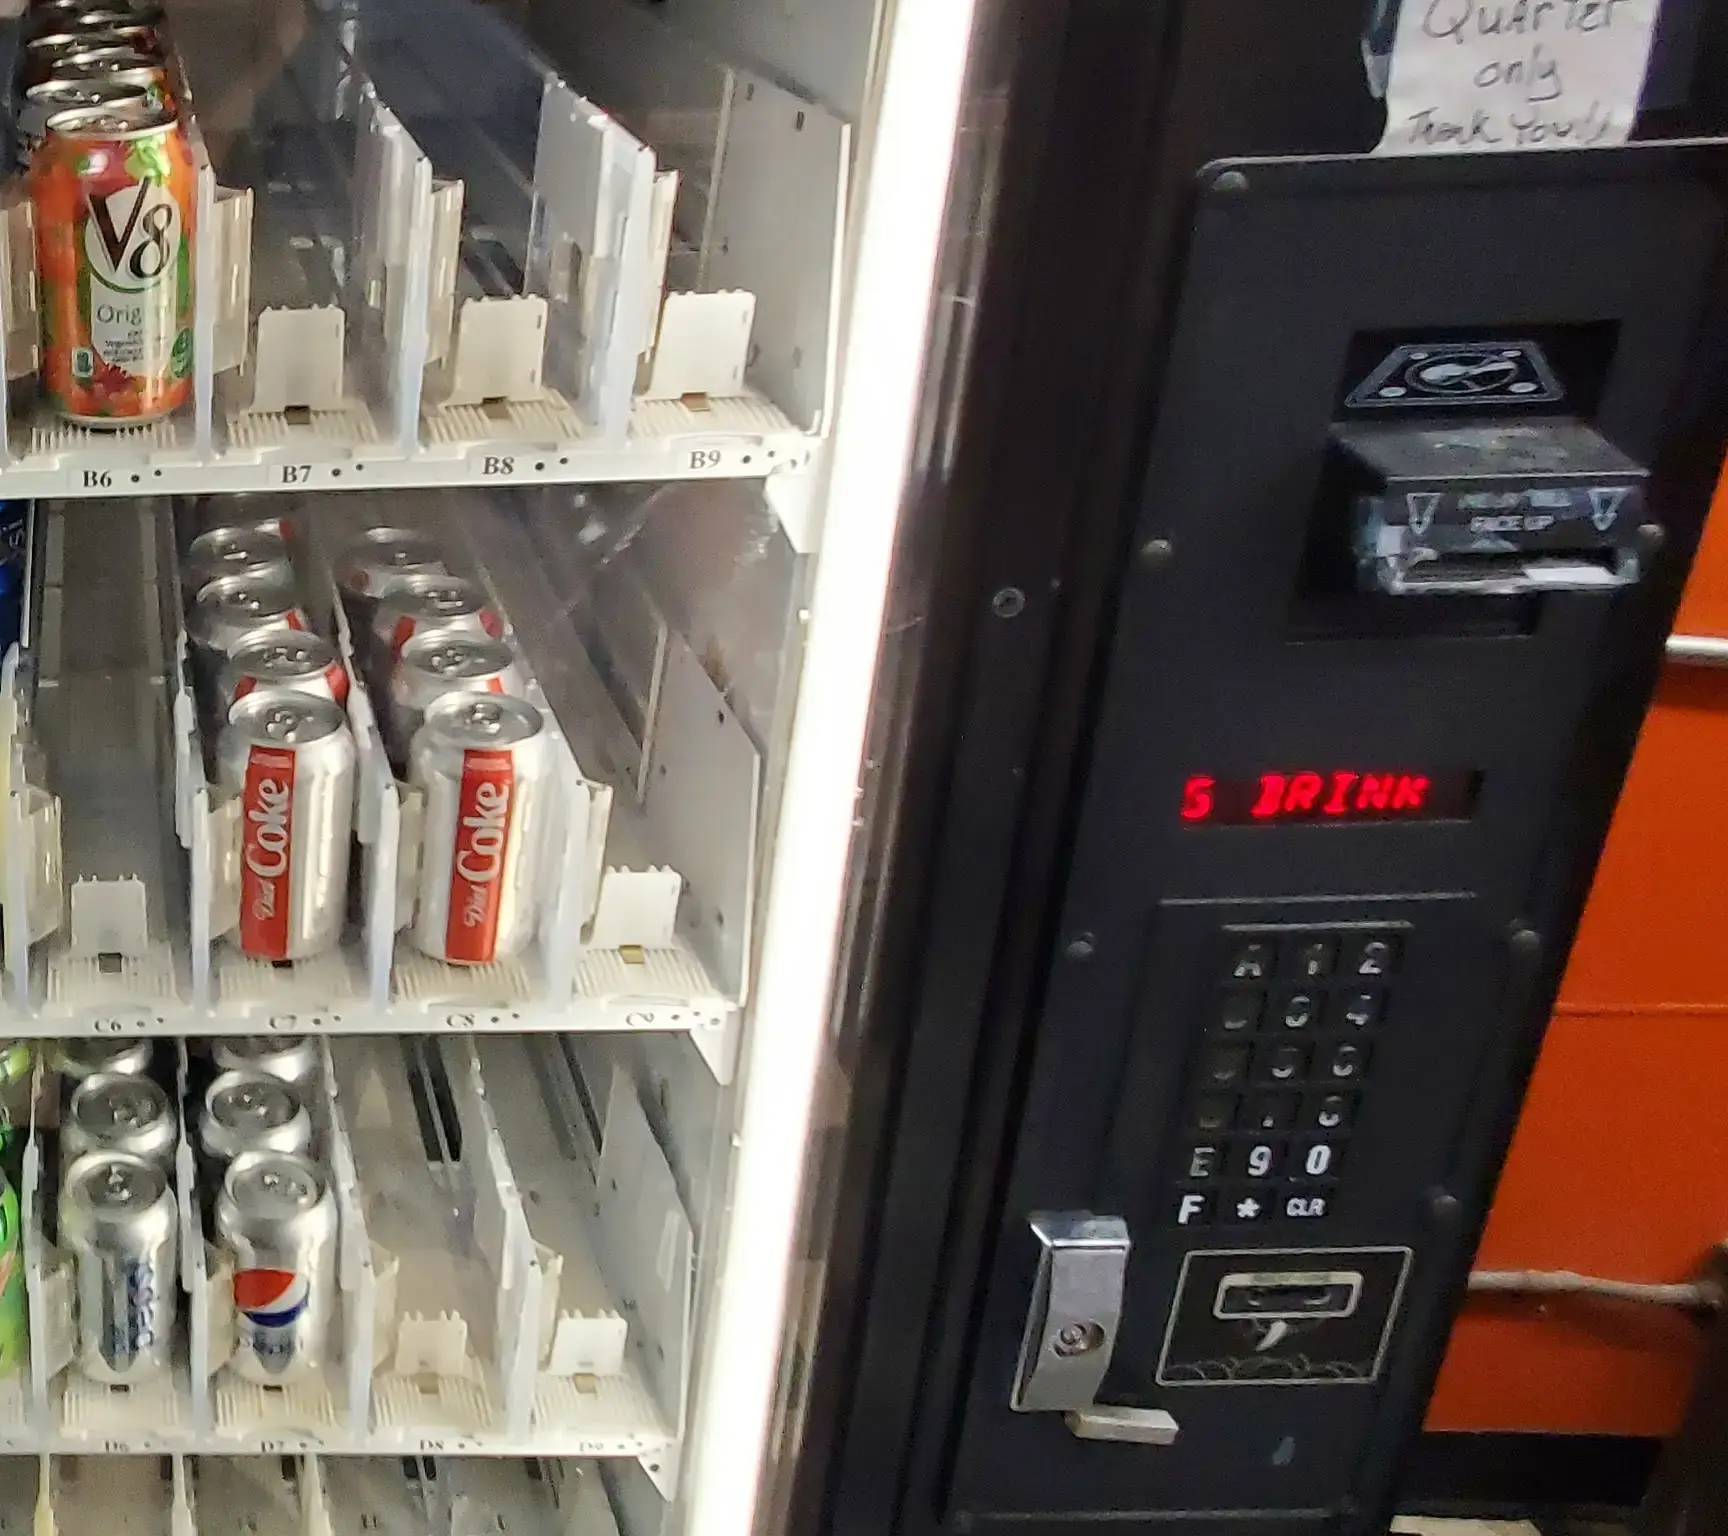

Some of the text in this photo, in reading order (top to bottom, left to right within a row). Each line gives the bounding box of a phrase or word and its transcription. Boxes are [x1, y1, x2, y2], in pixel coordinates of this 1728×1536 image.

[1474, 42, 1564, 103] only
[88, 176, 174, 280] V8
[82, 468, 113, 489] B6
[281, 464, 313, 484] B7
[482, 455, 516, 476] B8
[689, 449, 723, 470] B9
[1251, 771, 1431, 819] DRINK
[247, 777, 290, 878] Coke
[457, 779, 512, 882] Coke
[1189, 1146, 1216, 1178] E
[1247, 1144, 1273, 1178] 9
[1305, 1143, 1332, 1176] 0
[1177, 1193, 1206, 1226] F
